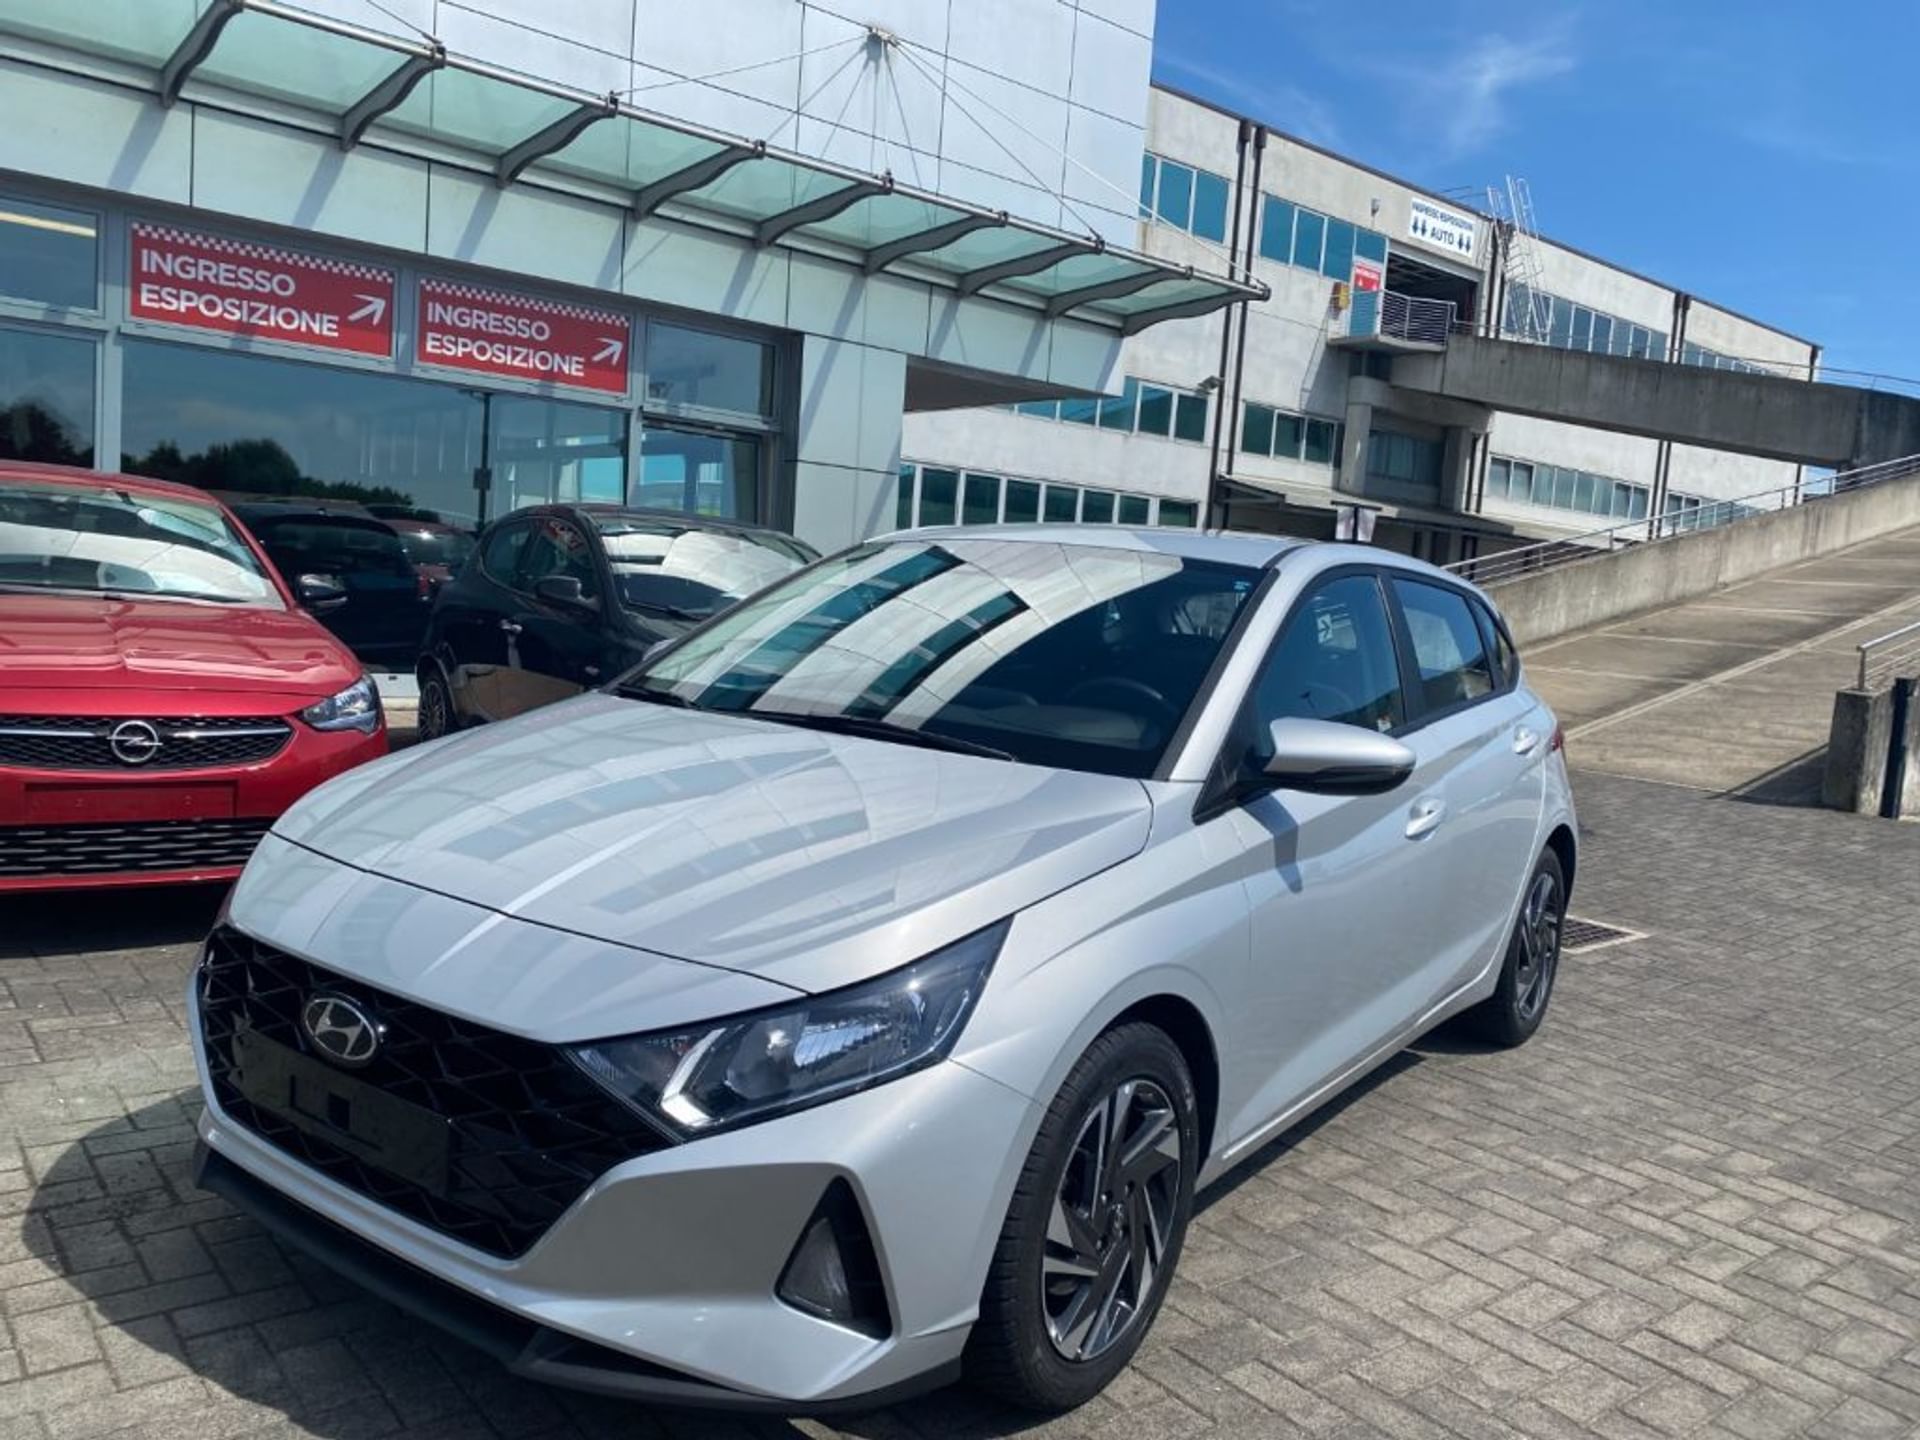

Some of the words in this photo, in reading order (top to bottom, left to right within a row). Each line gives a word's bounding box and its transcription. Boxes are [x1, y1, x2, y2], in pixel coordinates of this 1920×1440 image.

[1430, 227, 1454, 245] AUTO
[141, 249, 296, 296] INGRESSO
[140, 283, 339, 337] ESPOSIZIONE
[427, 301, 550, 341] INGRESSO
[425, 331, 585, 377] ESPOSIZIONE
